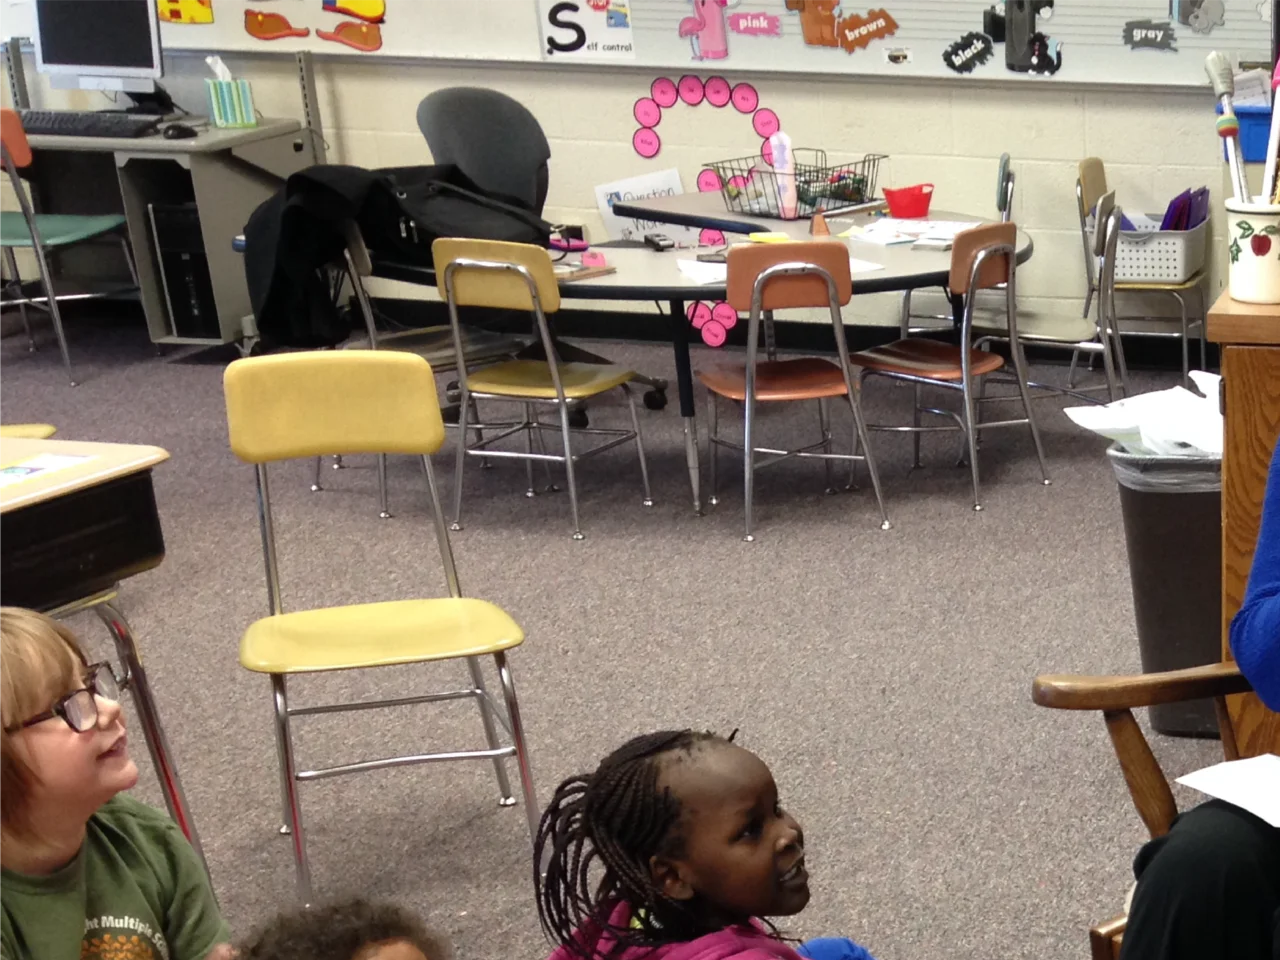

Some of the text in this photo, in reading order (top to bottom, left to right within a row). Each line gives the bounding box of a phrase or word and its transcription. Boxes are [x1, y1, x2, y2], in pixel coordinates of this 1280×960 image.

[739, 14, 768, 30] pink
[844, 17, 886, 42] brown
[1132, 28, 1164, 42] gray
[602, 43, 633, 52] control
[951, 38, 985, 67] black
[101, 916, 152, 937] Multiple
